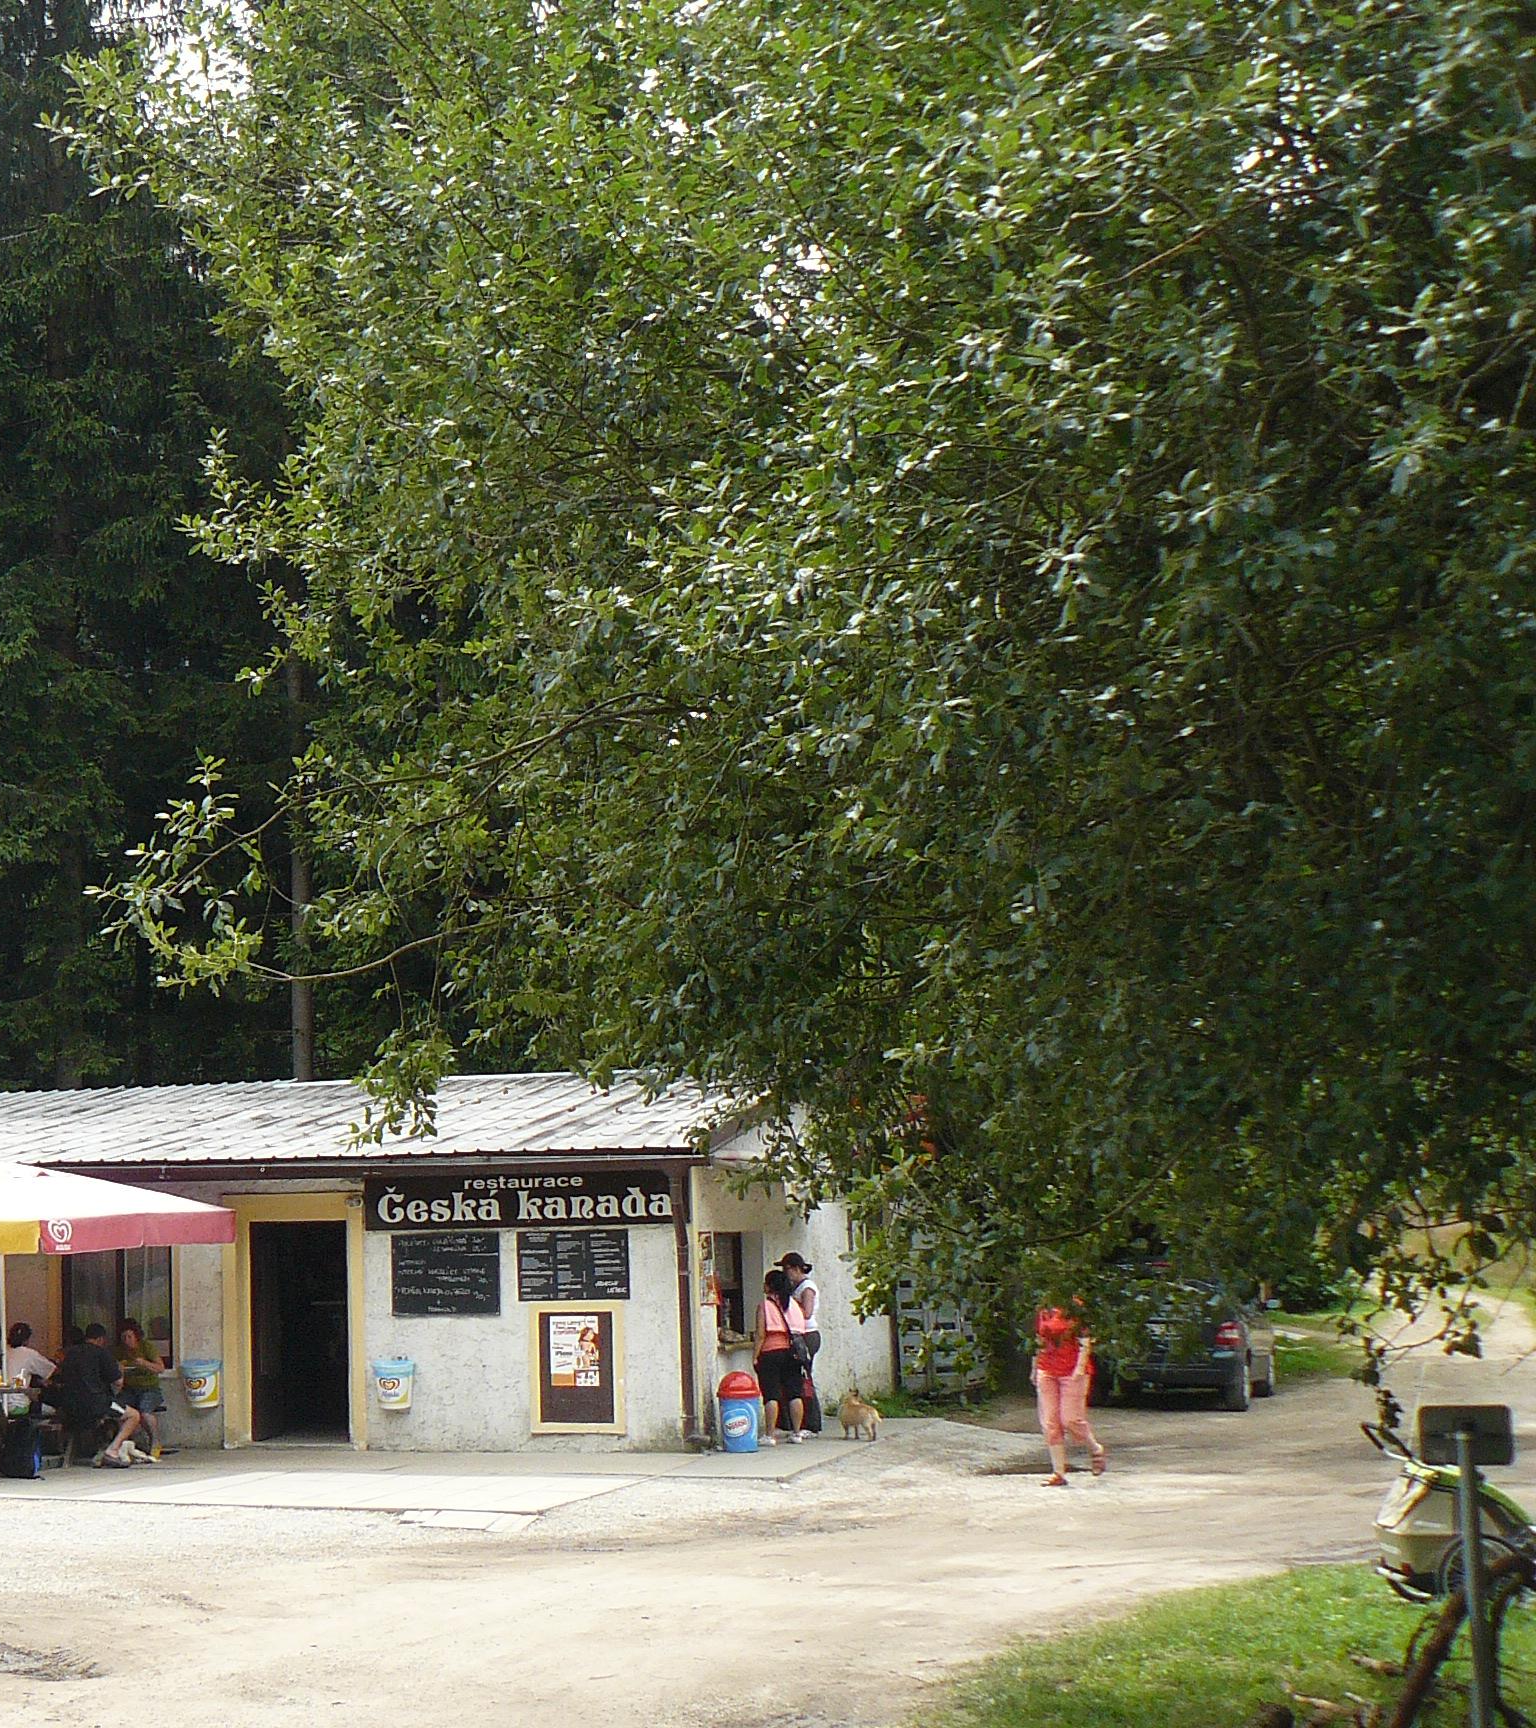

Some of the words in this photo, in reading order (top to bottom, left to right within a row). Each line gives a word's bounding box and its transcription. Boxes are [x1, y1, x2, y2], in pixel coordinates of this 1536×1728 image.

[464, 1174, 584, 1190] restaurace
[377, 1186, 502, 1223] Česká
[516, 1186, 673, 1220] kanada
